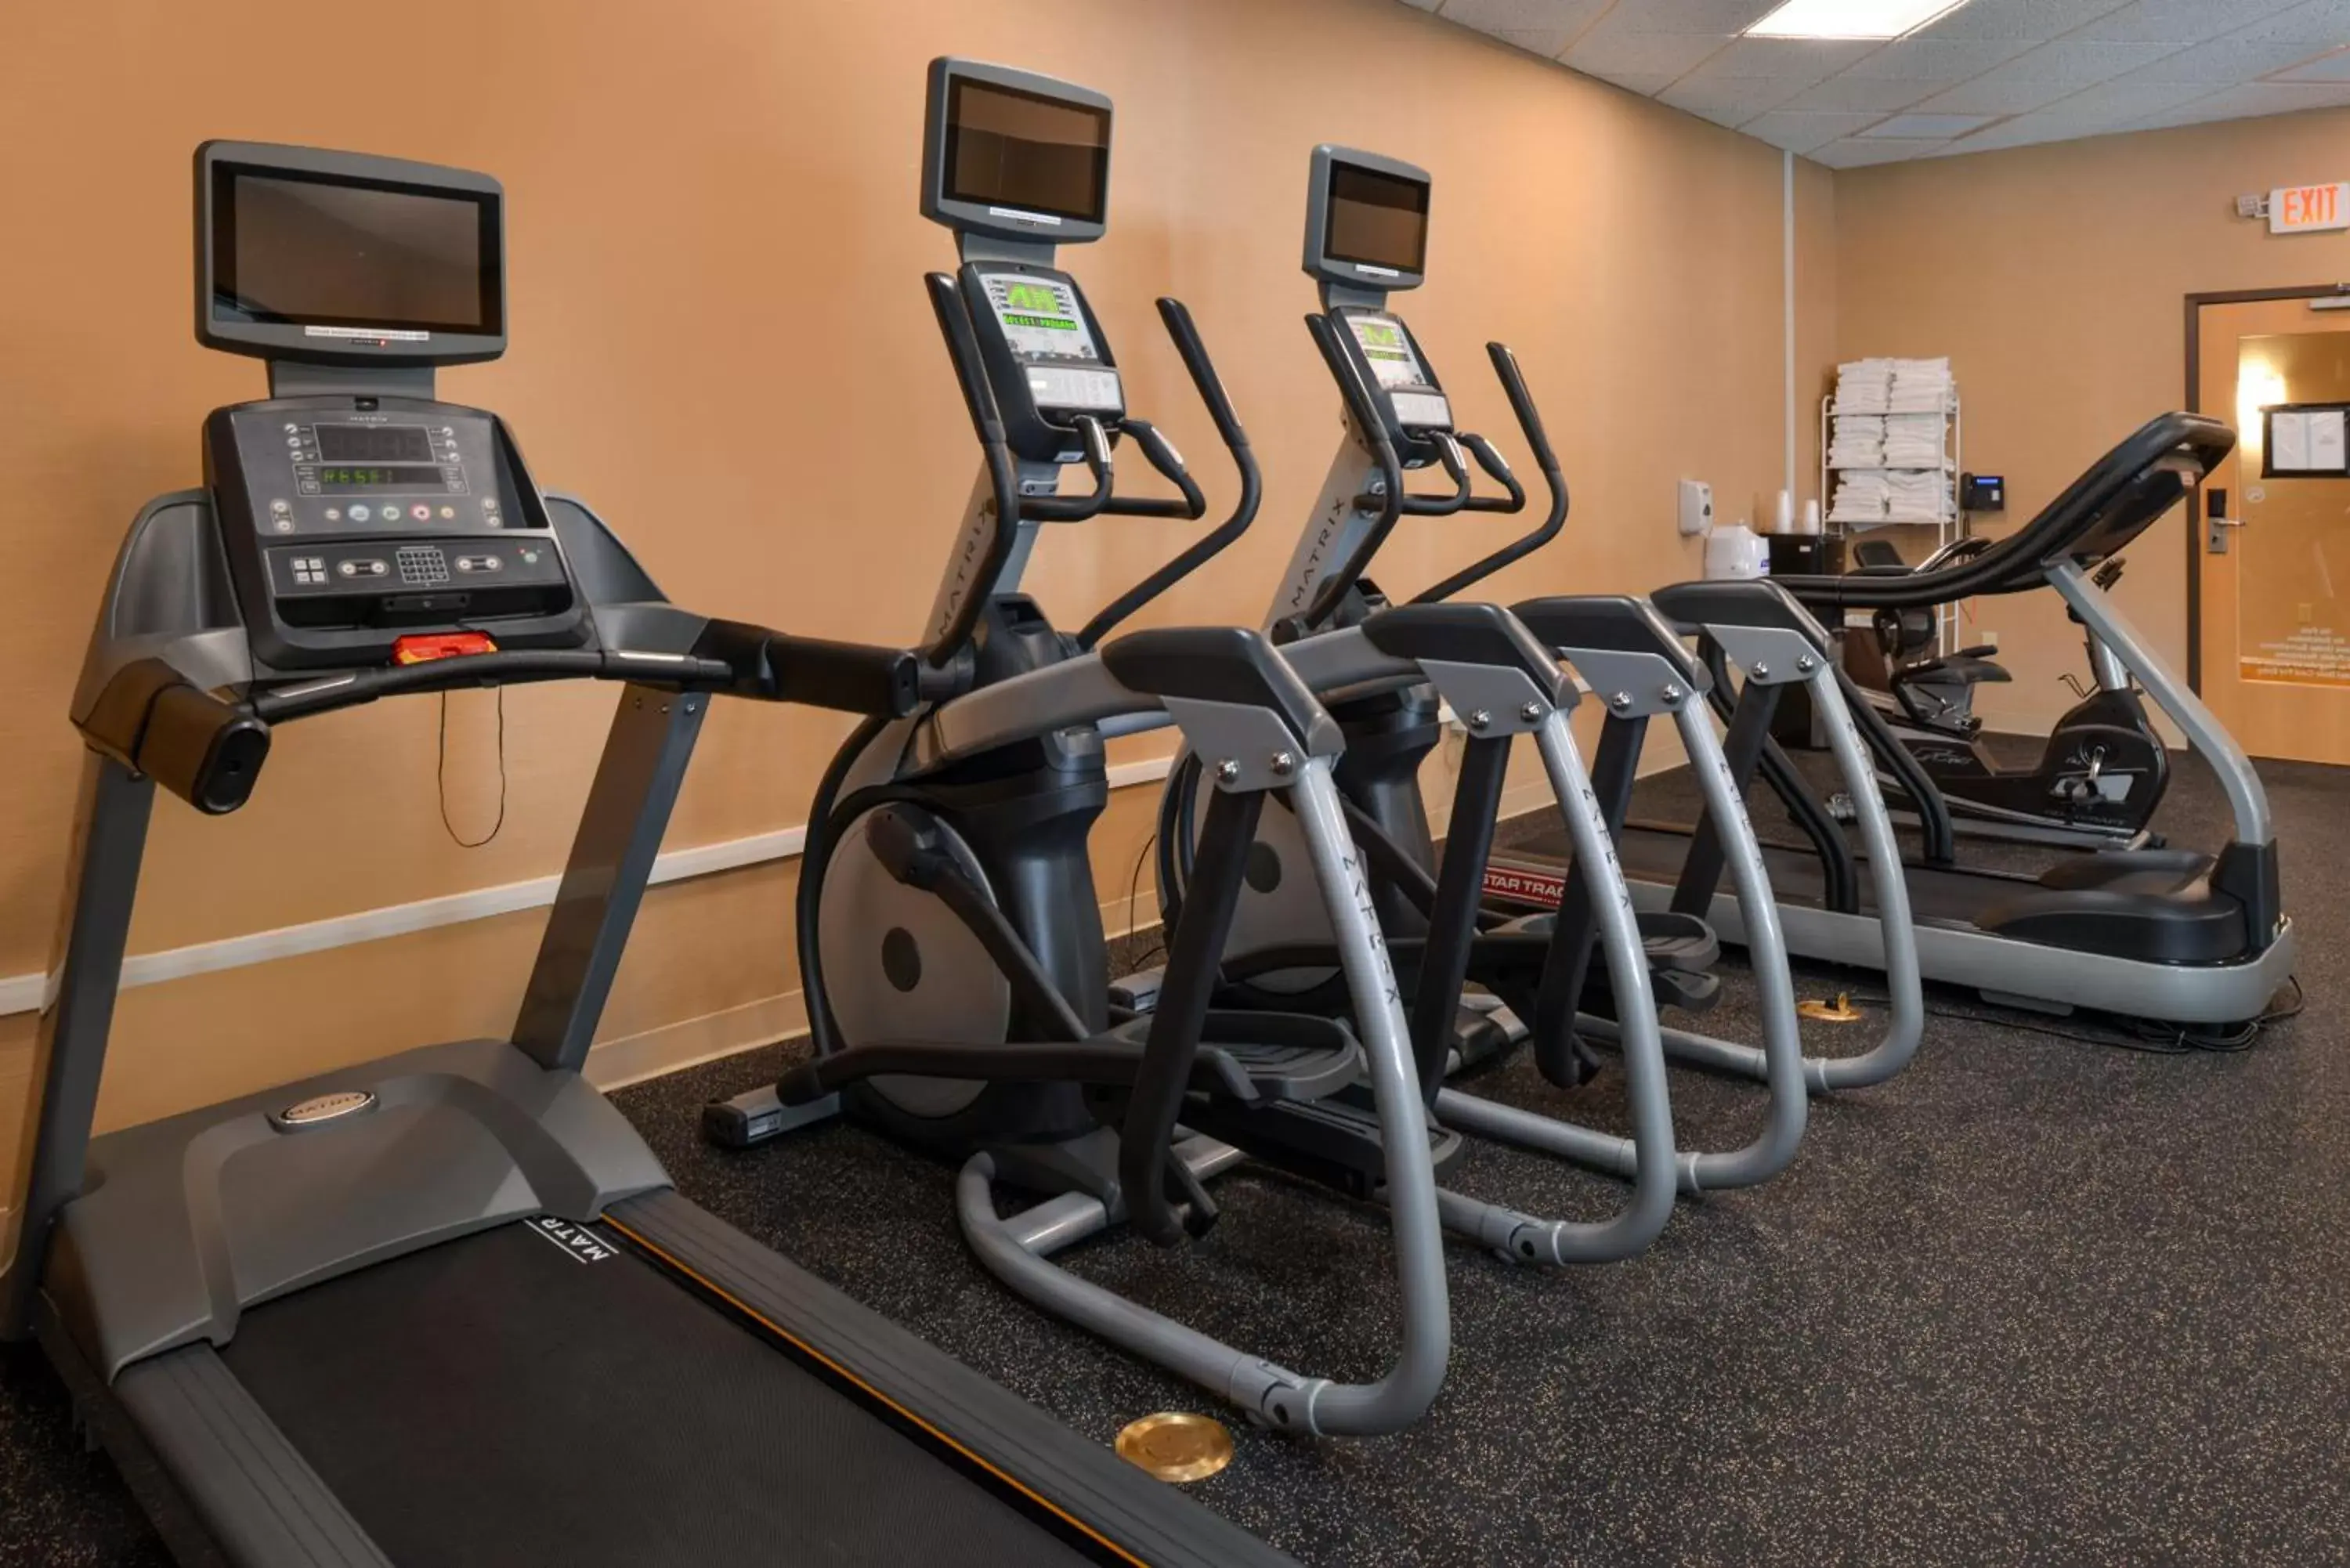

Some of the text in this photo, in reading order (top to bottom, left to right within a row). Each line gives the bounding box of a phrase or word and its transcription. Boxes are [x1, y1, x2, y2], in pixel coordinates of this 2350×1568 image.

[2283, 185, 2338, 226] EXIT
[938, 504, 985, 637] MATRIX
[1292, 497, 1344, 607] MATRIX
[1343, 857, 1401, 1003] MATRIX
